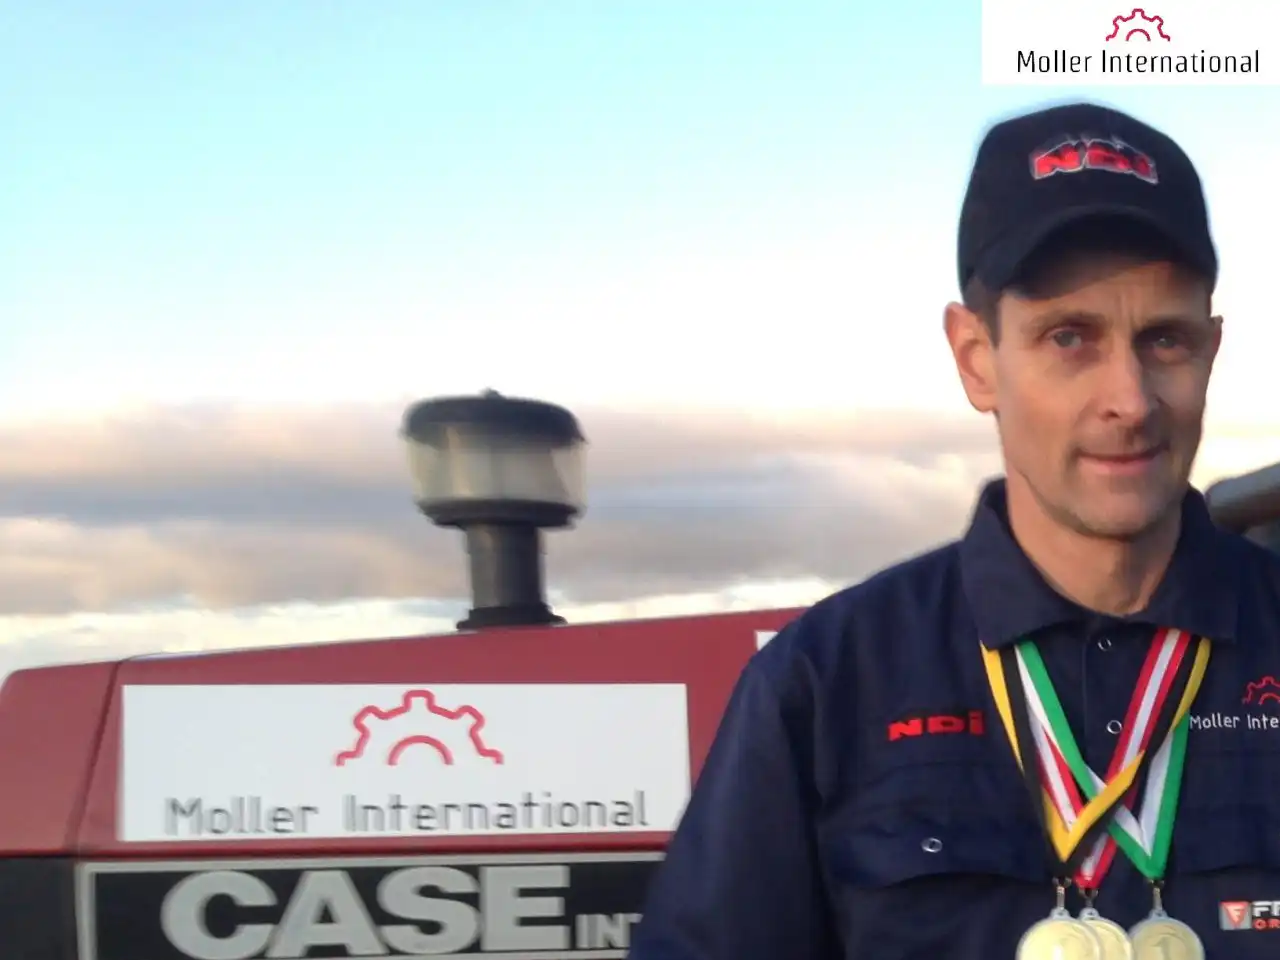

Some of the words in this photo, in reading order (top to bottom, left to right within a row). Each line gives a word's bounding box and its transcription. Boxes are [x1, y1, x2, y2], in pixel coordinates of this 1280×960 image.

[1189, 713, 1241, 731] Moller
[164, 795, 319, 836] Moller
[343, 790, 650, 832] International
